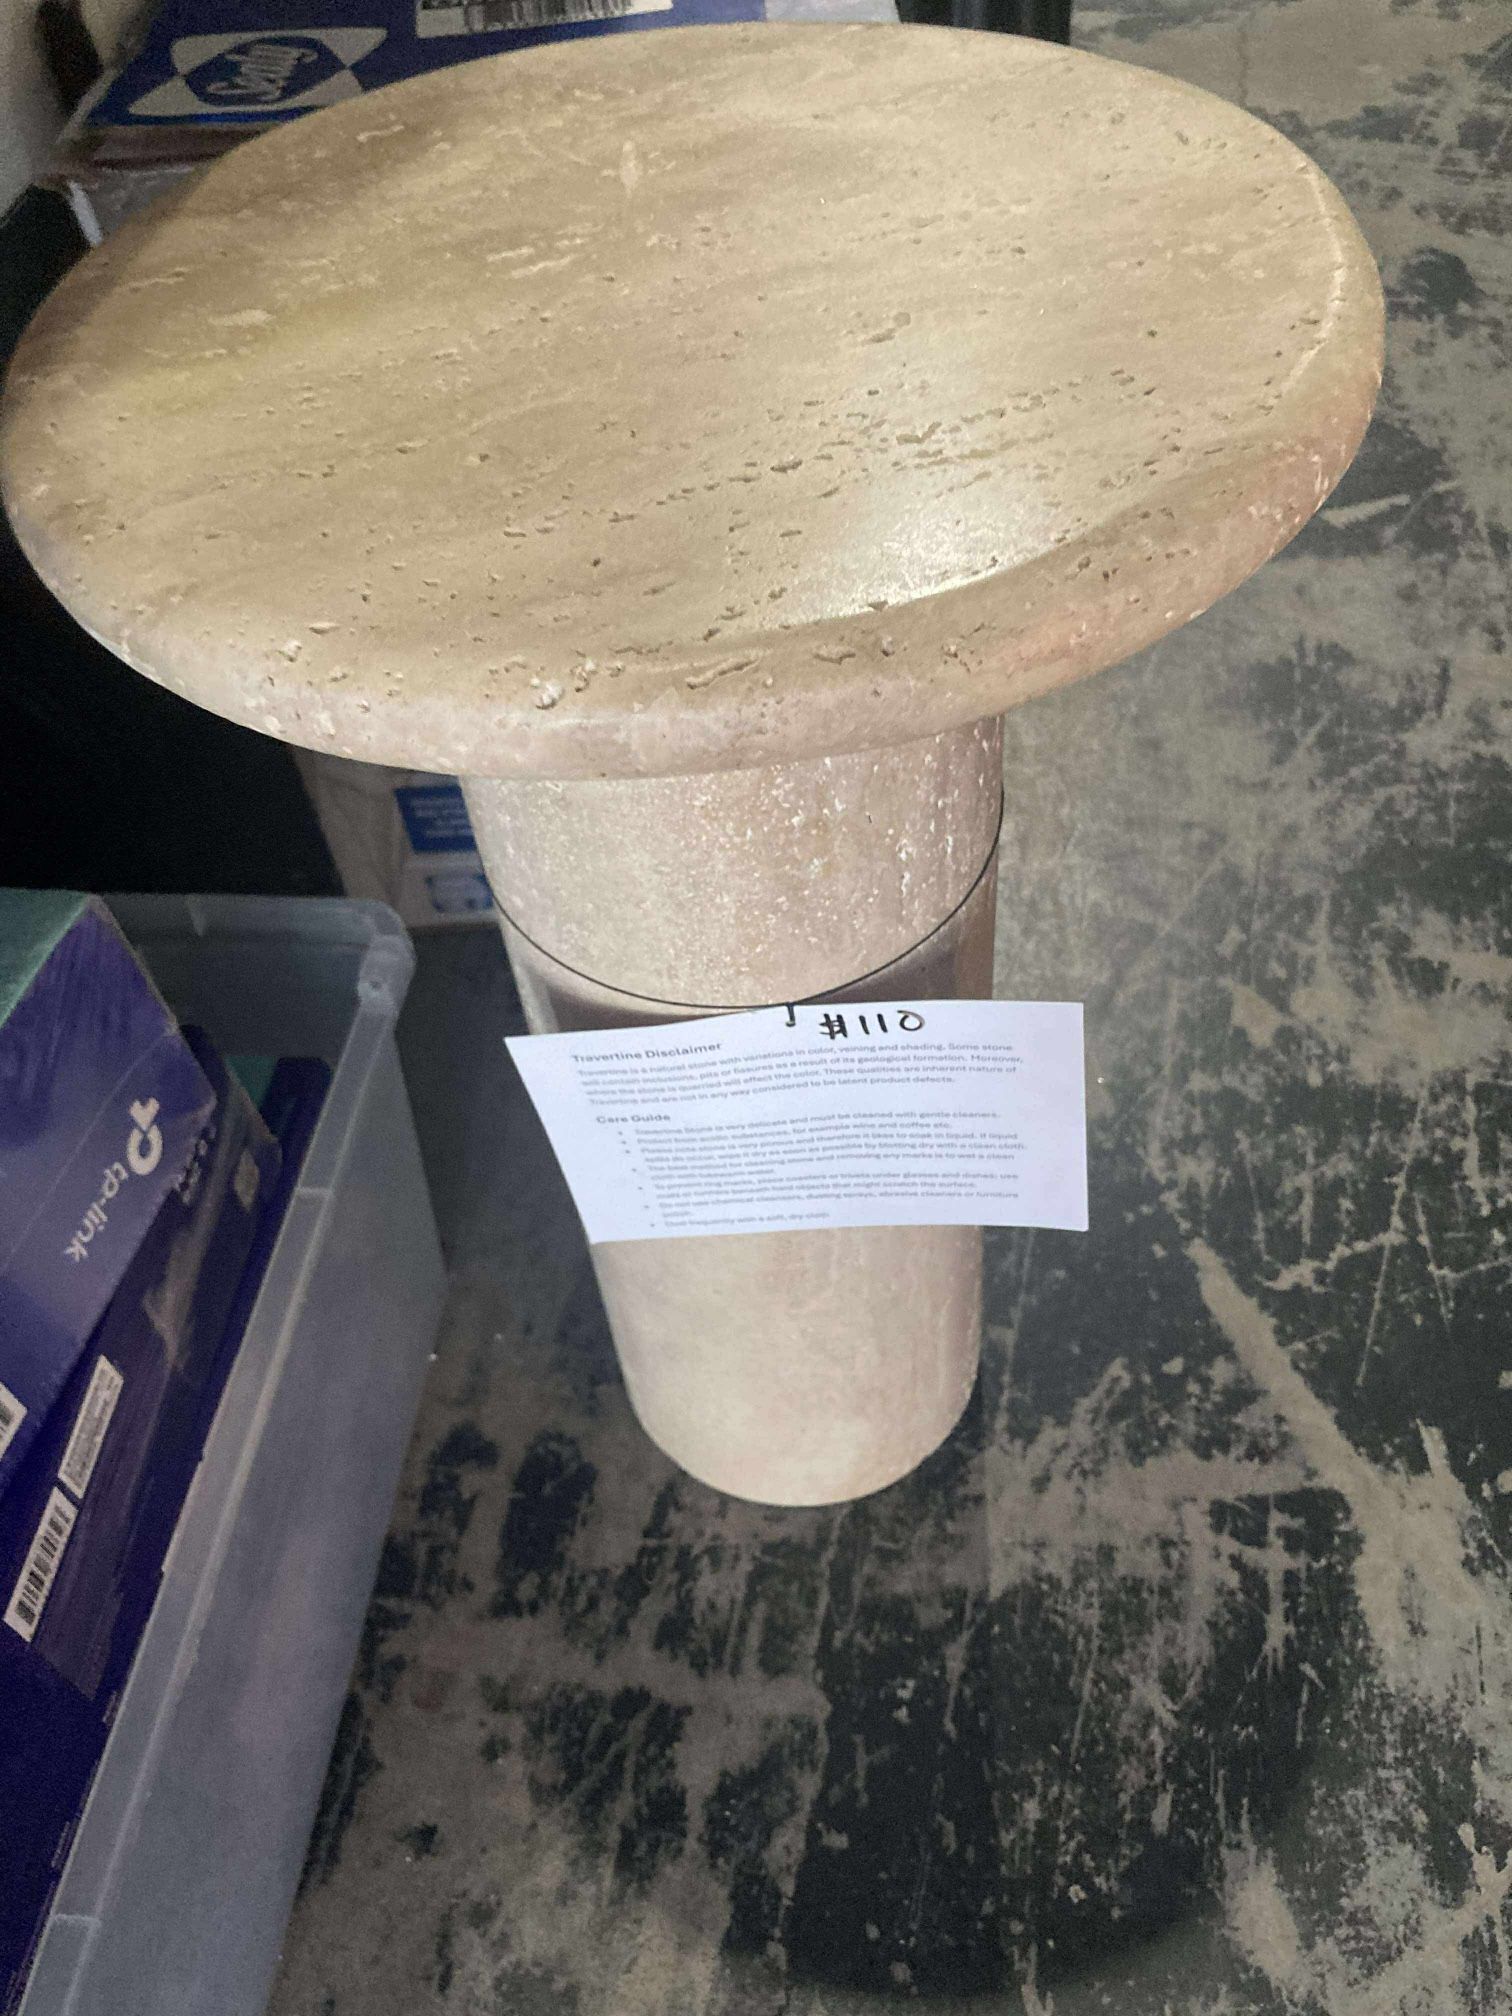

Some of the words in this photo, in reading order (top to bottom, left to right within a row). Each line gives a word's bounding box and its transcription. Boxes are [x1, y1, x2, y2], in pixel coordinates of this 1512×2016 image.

[818, 1009, 926, 1040] #110
[571, 1052, 642, 1063] Travertine
[644, 1043, 722, 1059] Disclaimer
[649, 1063, 686, 1073] natural
[688, 1060, 717, 1069] stone
[719, 1056, 741, 1066] with
[742, 1050, 794, 1062] variations
[795, 1048, 805, 1056] in
[807, 1046, 837, 1055] color,
[839, 1045, 876, 1054] veining
[878, 1044, 898, 1052] and
[900, 1042, 946, 1052] shading.
[948, 1042, 980, 1051] Some
[981, 1043, 1013, 1051] stone
[699, 1070, 720, 1081] pits
[733, 1064, 774, 1075] fissures
[798, 1058, 828, 1067] result
[829, 1056, 841, 1065] of
[842, 1055, 855, 1064] its
[857, 1054, 911, 1065] geological
[912, 1053, 968, 1063] formation.
[970, 1053, 1023, 1065] Moreover,
[678, 1081, 722, 1092] quarried
[722, 1078, 742, 1087] will
[774, 1071, 792, 1080] the
[823, 1067, 855, 1076] These
[856, 1065, 901, 1075] qualities
[922, 1065, 967, 1073] inherent
[968, 1065, 1004, 1074] nature
[1005, 1065, 1017, 1074] of
[640, 1095, 660, 1104] and
[661, 1095, 679, 1103] are
[679, 1092, 697, 1102] not
[709, 1091, 729, 1100] any
[729, 1089, 750, 1098] way
[752, 1080, 809, 1095] considered
[809, 1078, 822, 1088] to
[823, 1078, 837, 1086] be
[838, 1076, 868, 1085] latent
[869, 1076, 911, 1086] product
[912, 1075, 955, 1084] defects.
[596, 1115, 629, 1125] Care
[629, 1113, 671, 1123] Guide
[747, 1118, 788, 1129] delicate
[789, 1116, 809, 1125] and
[810, 1113, 836, 1122] must
[837, 1112, 851, 1120] be
[852, 1111, 893, 1120] cleaned
[894, 1110, 917, 1119] with
[919, 1110, 952, 1120] gentle
[952, 1110, 1001, 1119] cleaners.
[792, 1127, 807, 1135] for
[807, 1123, 851, 1134] example
[851, 1122, 876, 1130] wine
[877, 1121, 898, 1129] and
[898, 1121, 931, 1129] coffee
[932, 1121, 952, 1129] etc.
[795, 1136, 816, 1146] and
[816, 1133, 862, 1143] therefore
[895, 1132, 907, 1140] to
[988, 1132, 1019, 1142] liquid
[821, 1141, 863, 1153] possible
[863, 1141, 877, 1150] by
[877, 1141, 918, 1151] blotting
[917, 1141, 935, 1151] dry
[935, 1141, 958, 1150] with
[967, 1142, 997, 1150] clean
[997, 1142, 1028, 1151] cloth.
[743, 1157, 786, 1168] cleaning
[815, 1154, 835, 1163] and
[836, 1151, 882, 1162] removing
[882, 1151, 901, 1161] any
[901, 1151, 933, 1160] marks
[956, 1152, 977, 1160] wet
[985, 1152, 1016, 1161] clean
[852, 1180, 881, 1190] might
[919, 1180, 937, 1189] the
[941, 1171, 961, 1180] and
[999, 1173, 1020, 1181] use
[974, 1190, 1020, 1200] furniture
[64, 1161, 129, 1263] tp-link
